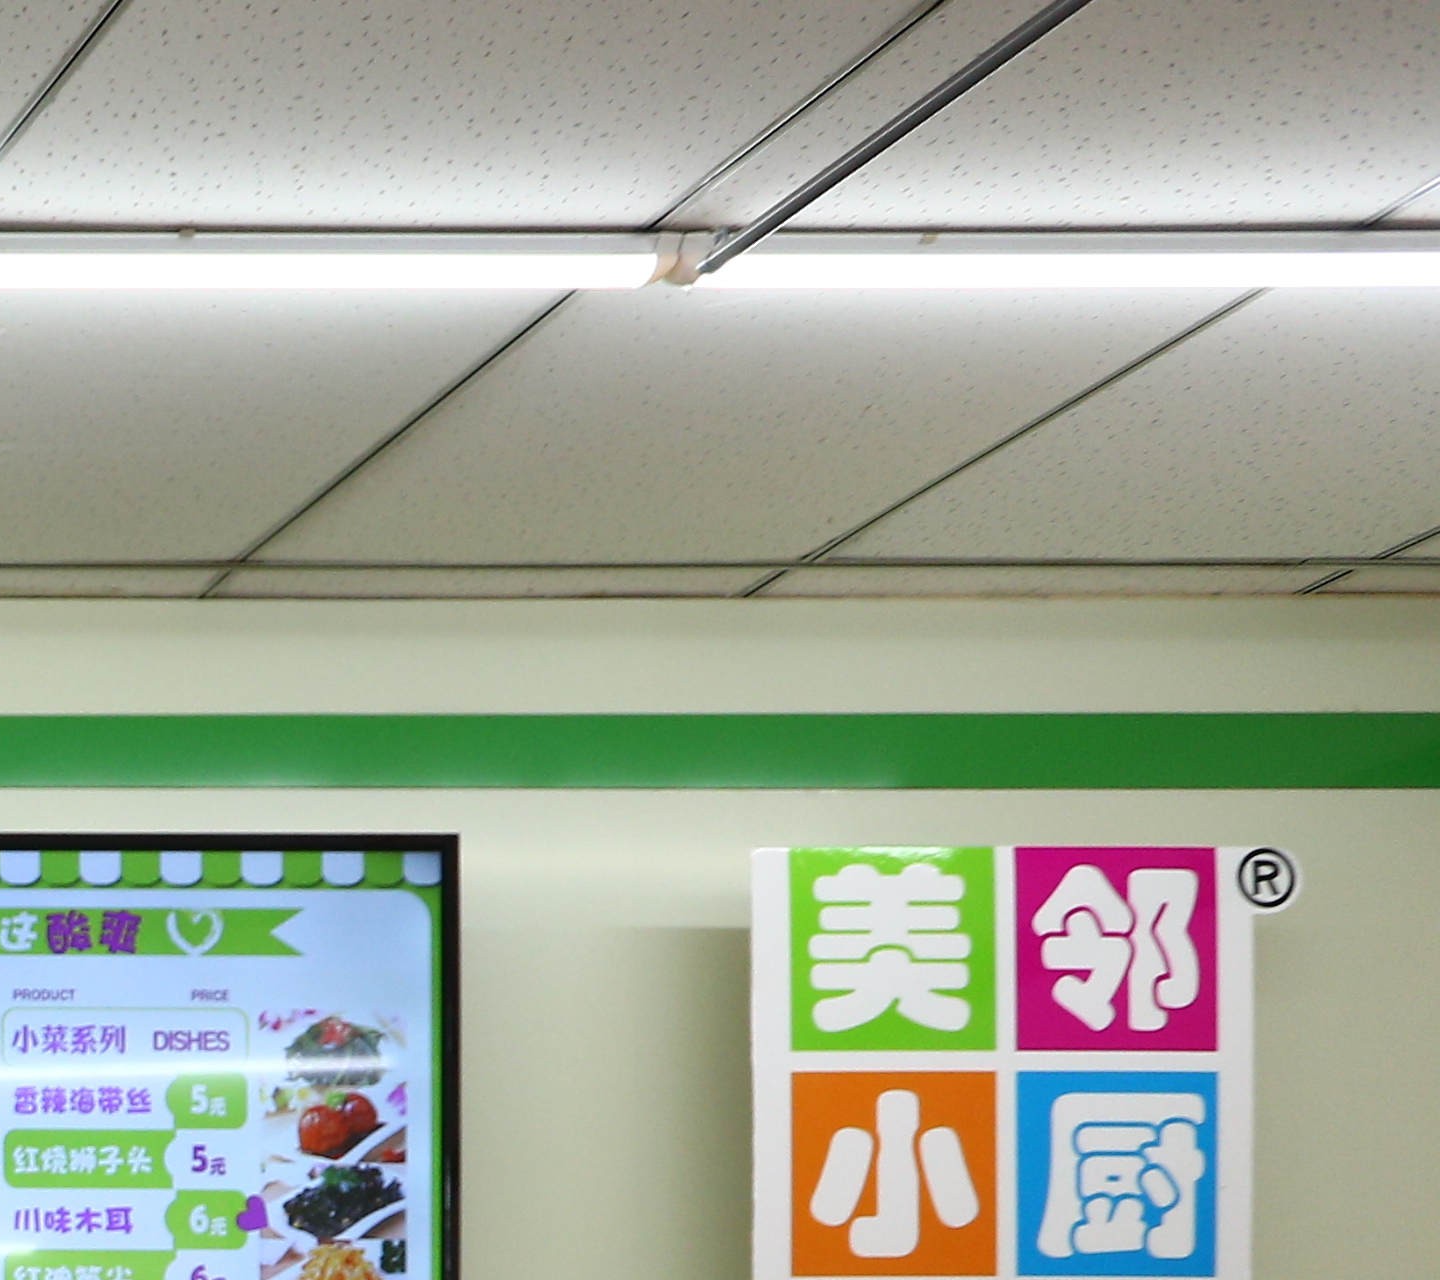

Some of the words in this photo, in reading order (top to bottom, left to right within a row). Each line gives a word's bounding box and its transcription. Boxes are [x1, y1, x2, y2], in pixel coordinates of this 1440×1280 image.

[808, 864, 1199, 1033] 美邻
[13, 989, 75, 1001] PRODUCT
[191, 989, 229, 1001] PRICE
[11, 1024, 127, 1055] 小菜系列
[153, 1029, 231, 1052] DISHES
[13, 1085, 152, 1115] 香辣海带丝
[190, 1085, 227, 1118] 5元
[12, 1144, 153, 1175] 红烧狮子头
[191, 1145, 227, 1176] 5元
[810, 1089, 1206, 1259] 小厨
[14, 1206, 133, 1235] 川味木耳
[190, 1206, 227, 1237] 6元
